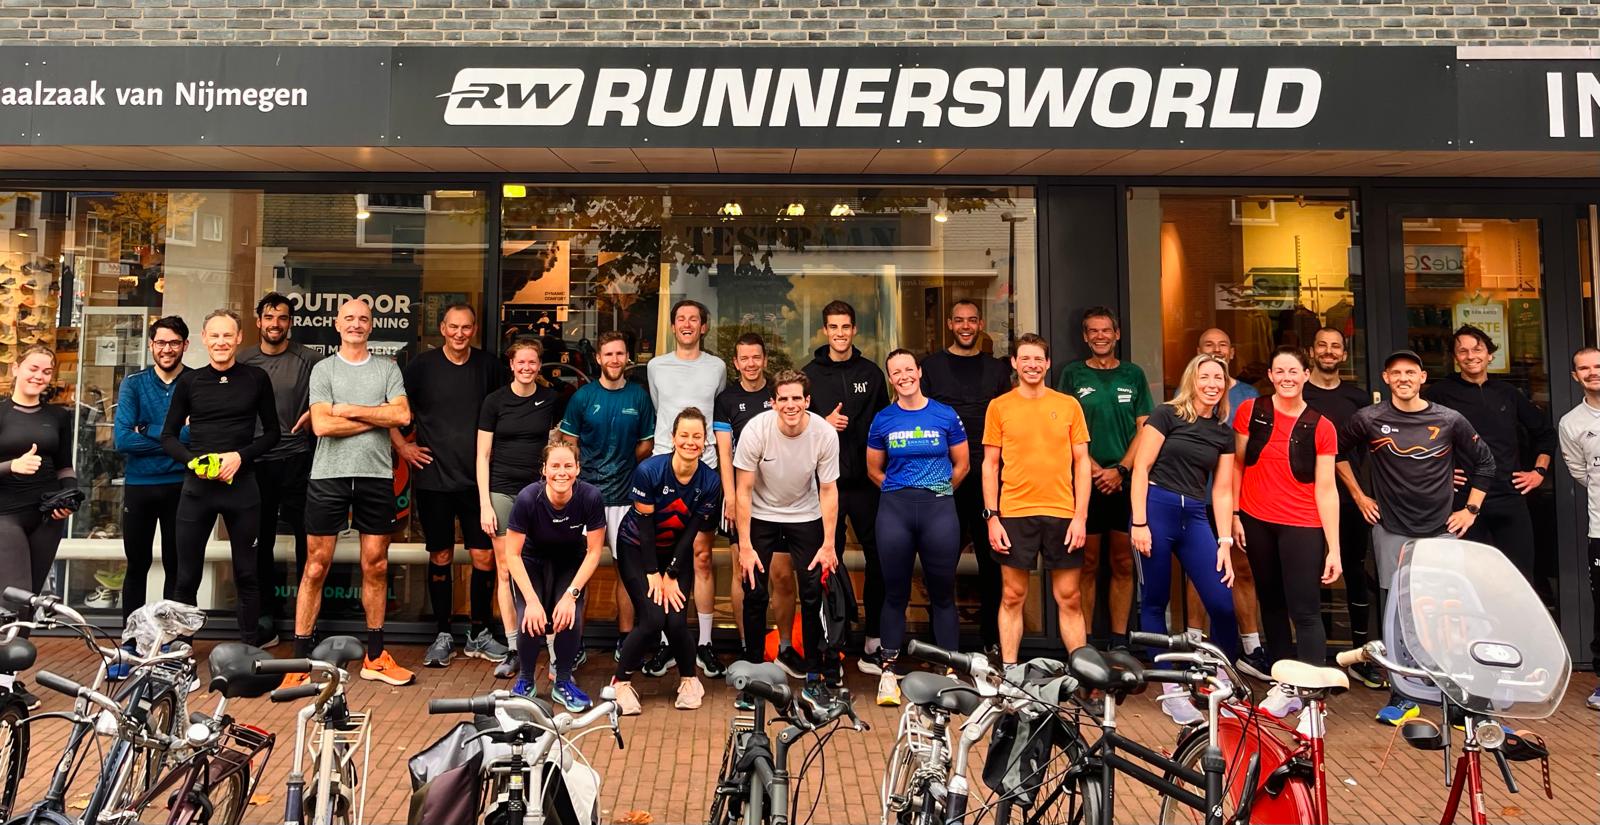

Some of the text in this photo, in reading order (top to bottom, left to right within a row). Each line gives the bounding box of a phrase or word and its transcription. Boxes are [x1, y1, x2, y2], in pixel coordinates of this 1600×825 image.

[1, 80, 308, 112] aalzaak van Nijmegen
[451, 82, 573, 110] RW
[588, 67, 1322, 129] RUNNERSWORLD
